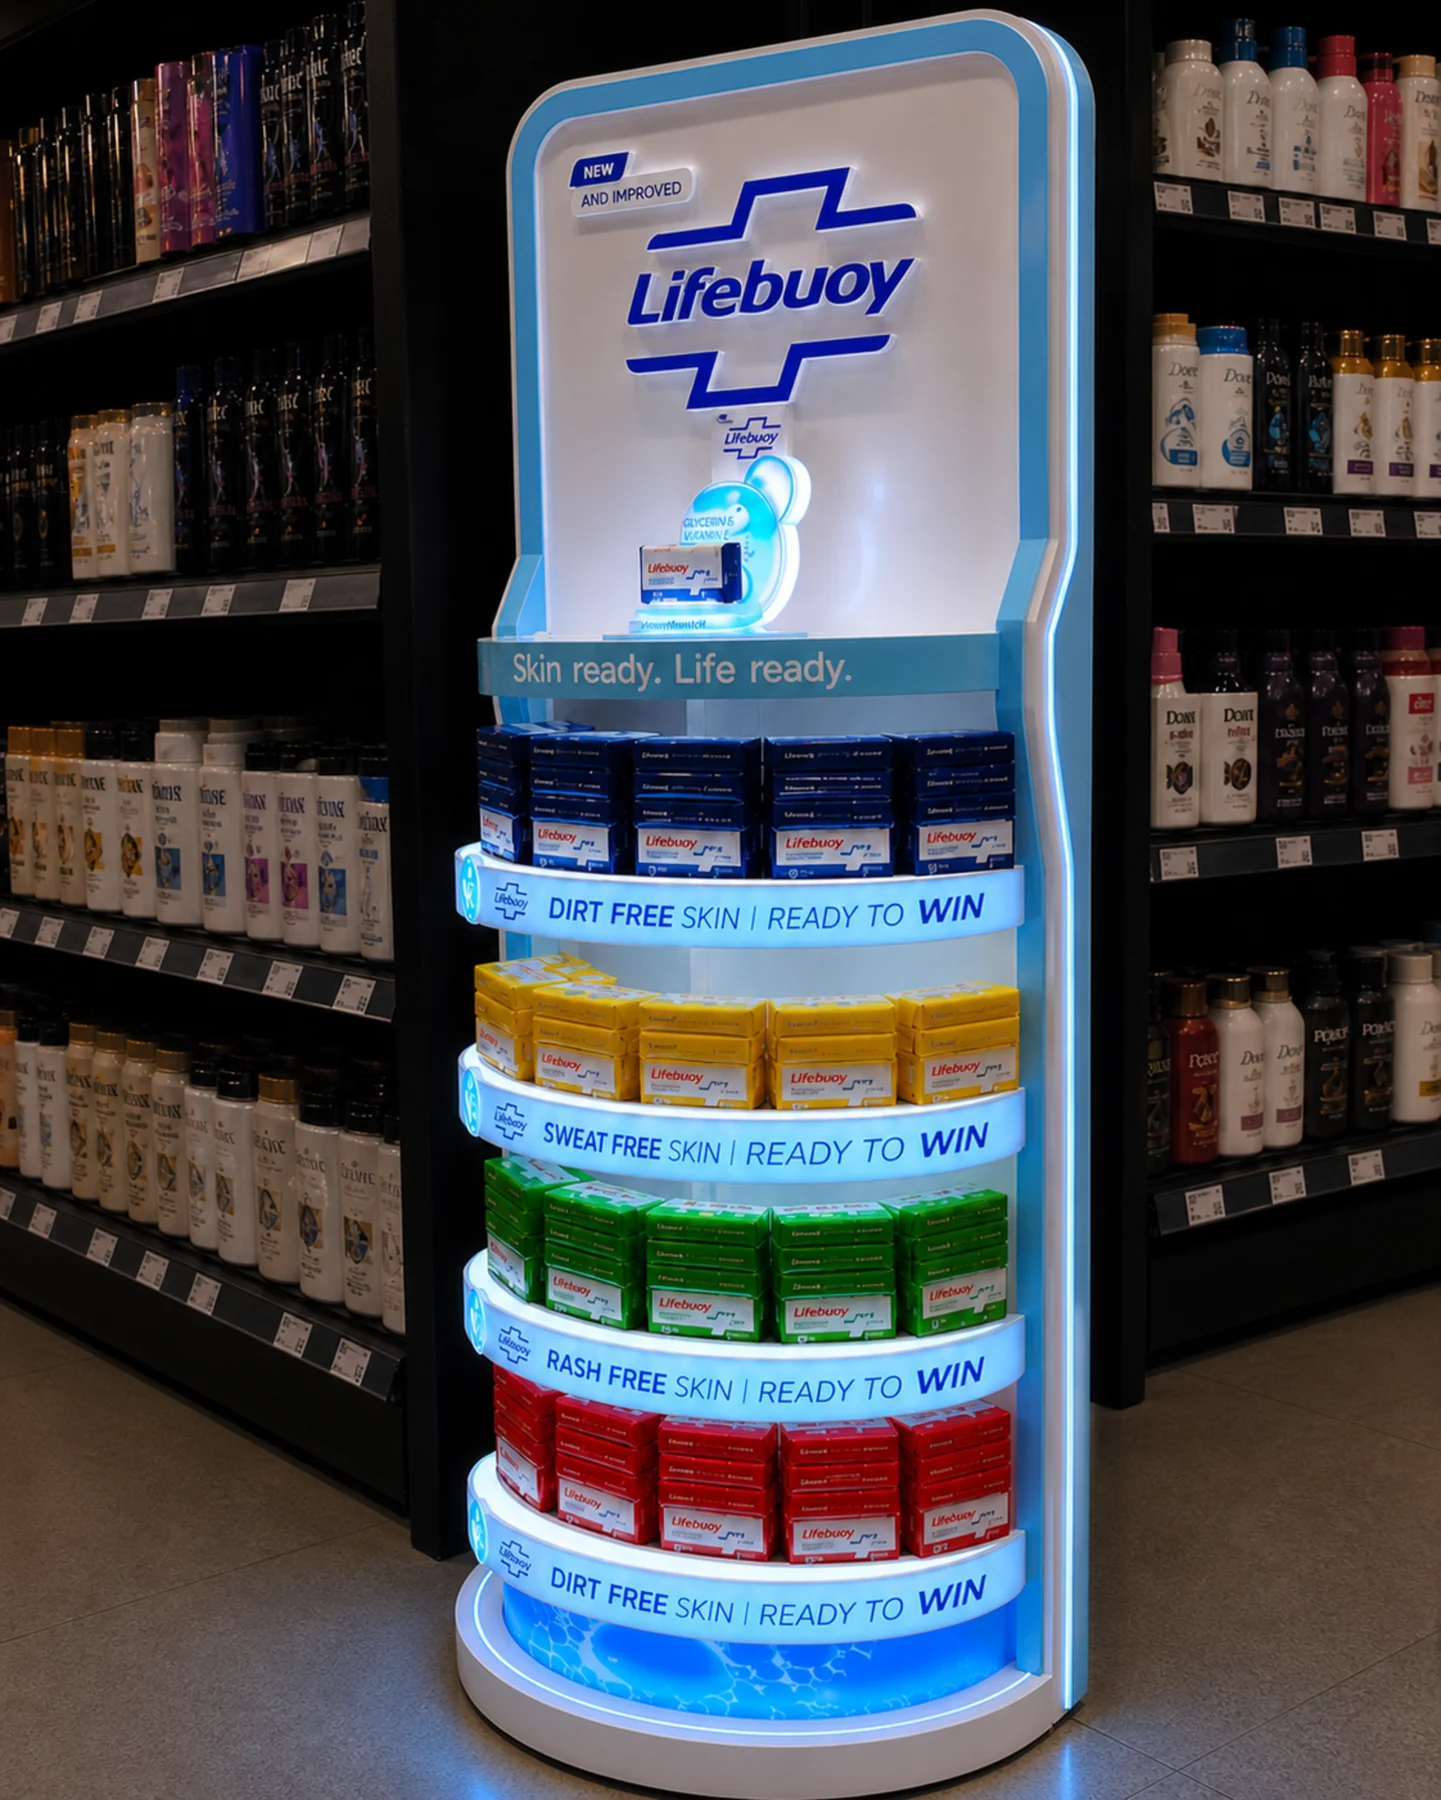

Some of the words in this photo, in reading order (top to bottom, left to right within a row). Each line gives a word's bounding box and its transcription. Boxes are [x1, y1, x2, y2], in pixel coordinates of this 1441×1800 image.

[583, 162, 614, 180] NEW
[581, 192, 609, 208] AND
[613, 181, 682, 204] IMPROVED
[627, 258, 915, 326] Lifebuoy
[724, 432, 778, 445] Lifebuoy
[648, 563, 688, 574] Lifebuoy
[513, 653, 561, 683] Skin
[573, 654, 661, 692] ready.
[675, 652, 735, 684] Life
[750, 651, 852, 690] ready.
[538, 827, 577, 844] Lifebuoy
[646, 835, 697, 850] Lifebuoy
[785, 837, 844, 850] Lifebuoy
[927, 831, 976, 843] Lifebuoy
[549, 897, 603, 922] DIRT
[610, 903, 675, 927] FREE
[681, 906, 740, 929] SKIN
[768, 906, 858, 929] READY
[868, 903, 904, 927] TO
[919, 893, 985, 924] WIN
[541, 1053, 581, 1071] Lifebuoy
[931, 1061, 981, 1077] Lifebuoy
[651, 1068, 704, 1084] Lifebuoy
[791, 1073, 848, 1084] Lifebuoy
[543, 1122, 608, 1153] SWEAT
[612, 1134, 662, 1160] FREE
[668, 1139, 721, 1164] SKIN
[746, 1140, 852, 1165] READY
[863, 1137, 904, 1162] TO
[921, 1121, 989, 1157] WIN
[553, 1275, 591, 1298] Lifebuoy
[929, 1284, 974, 1301] Lifebuoy
[659, 1297, 712, 1313] Lifebuoy
[794, 1306, 849, 1318] Lifebuoy
[547, 1349, 600, 1382] RASH
[608, 1366, 667, 1395] FREE
[675, 1375, 733, 1401] SKIN
[758, 1379, 855, 1403] READY
[864, 1375, 902, 1400] TO
[917, 1356, 985, 1395] WIN
[564, 1487, 602, 1510] Lifebuoy
[672, 1516, 722, 1533] Lifebuoy
[932, 1510, 975, 1528] Lifebuoy
[802, 1528, 854, 1540] Lifebuoy
[551, 1567, 601, 1599] DIRT
[608, 1584, 668, 1615] FREE
[675, 1597, 734, 1623] SKIN
[759, 1601, 856, 1626] READY
[866, 1597, 904, 1622] TO
[919, 1574, 987, 1615] WIN
